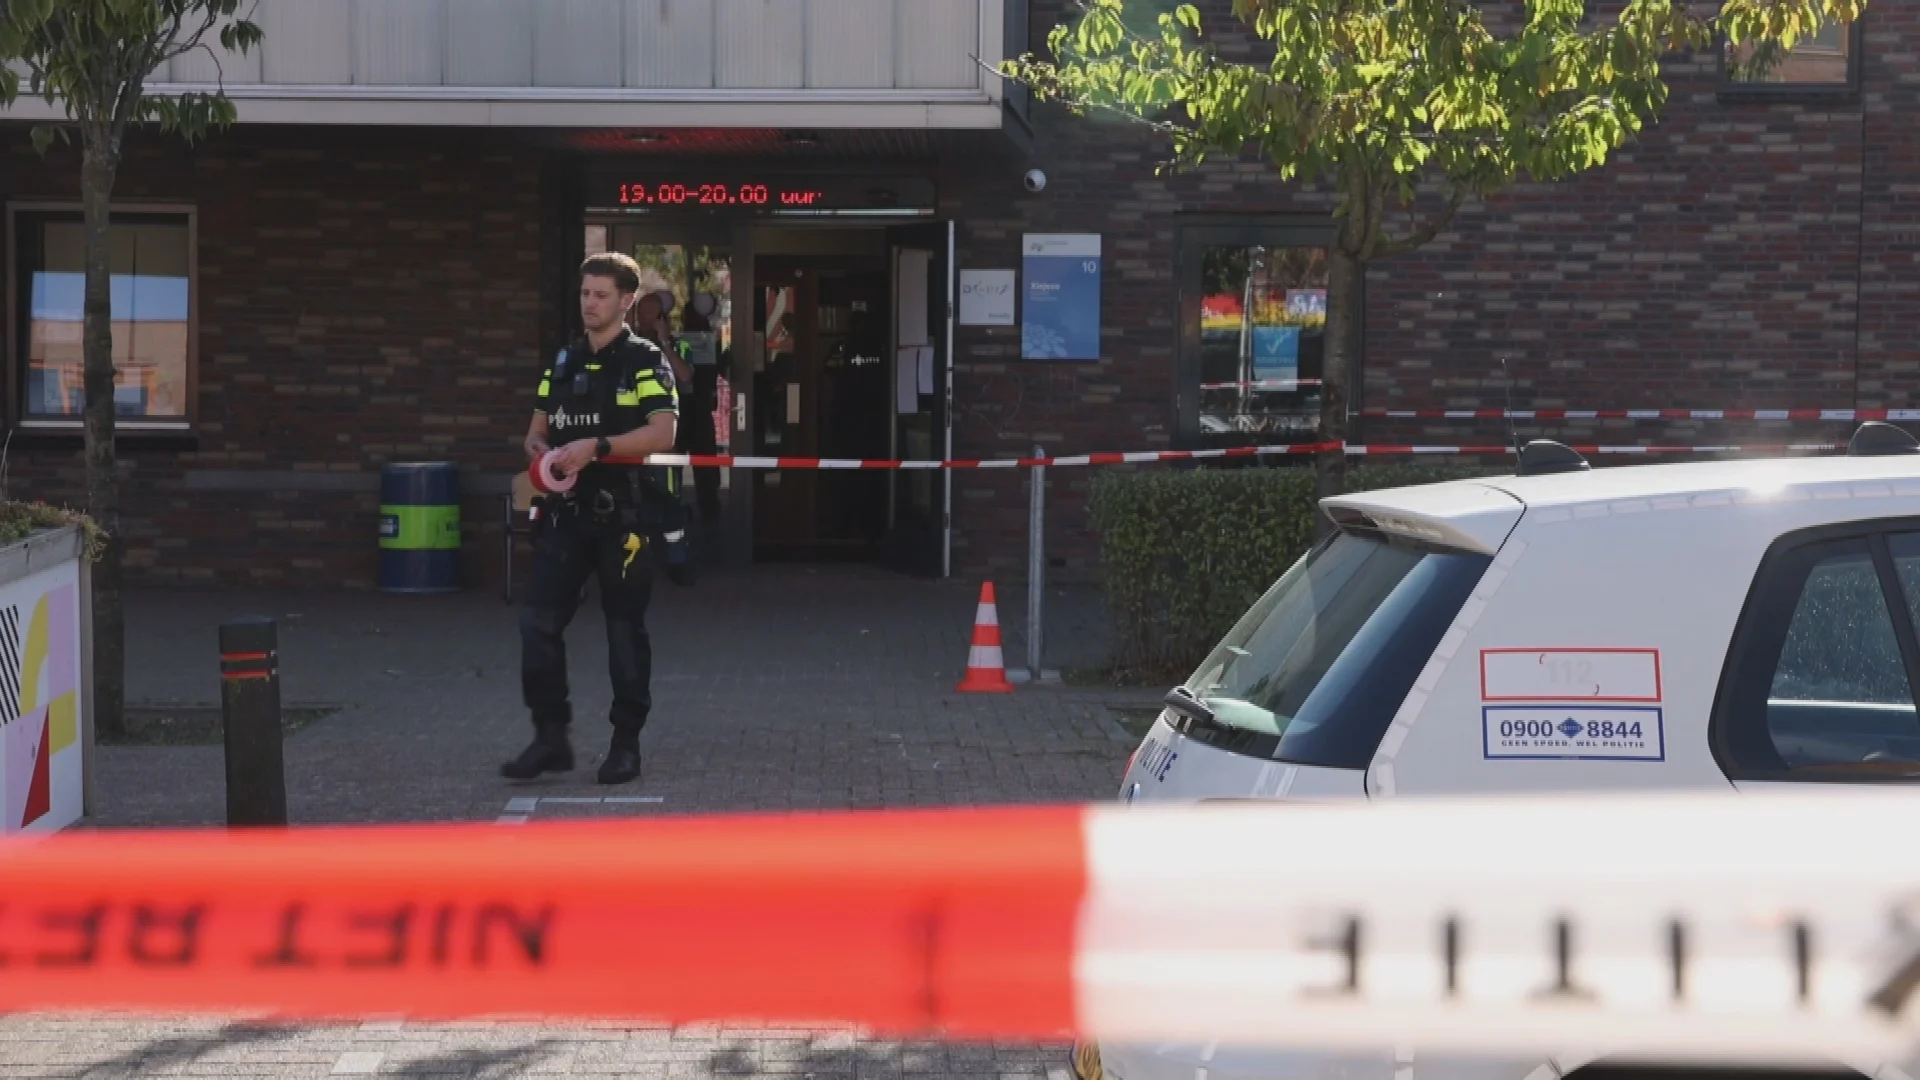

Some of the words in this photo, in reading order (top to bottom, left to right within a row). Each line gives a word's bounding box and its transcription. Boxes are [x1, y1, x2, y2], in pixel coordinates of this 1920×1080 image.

[619, 184, 768, 205] 19.00-20.00
[1082, 260, 1097, 273] 10
[548, 405, 601, 430] POLITIE
[1547, 659, 1594, 684] 112
[1500, 719, 1553, 738] 0900
[1587, 720, 1643, 739] 8844
[1603, 741, 1645, 749] POLITIE
